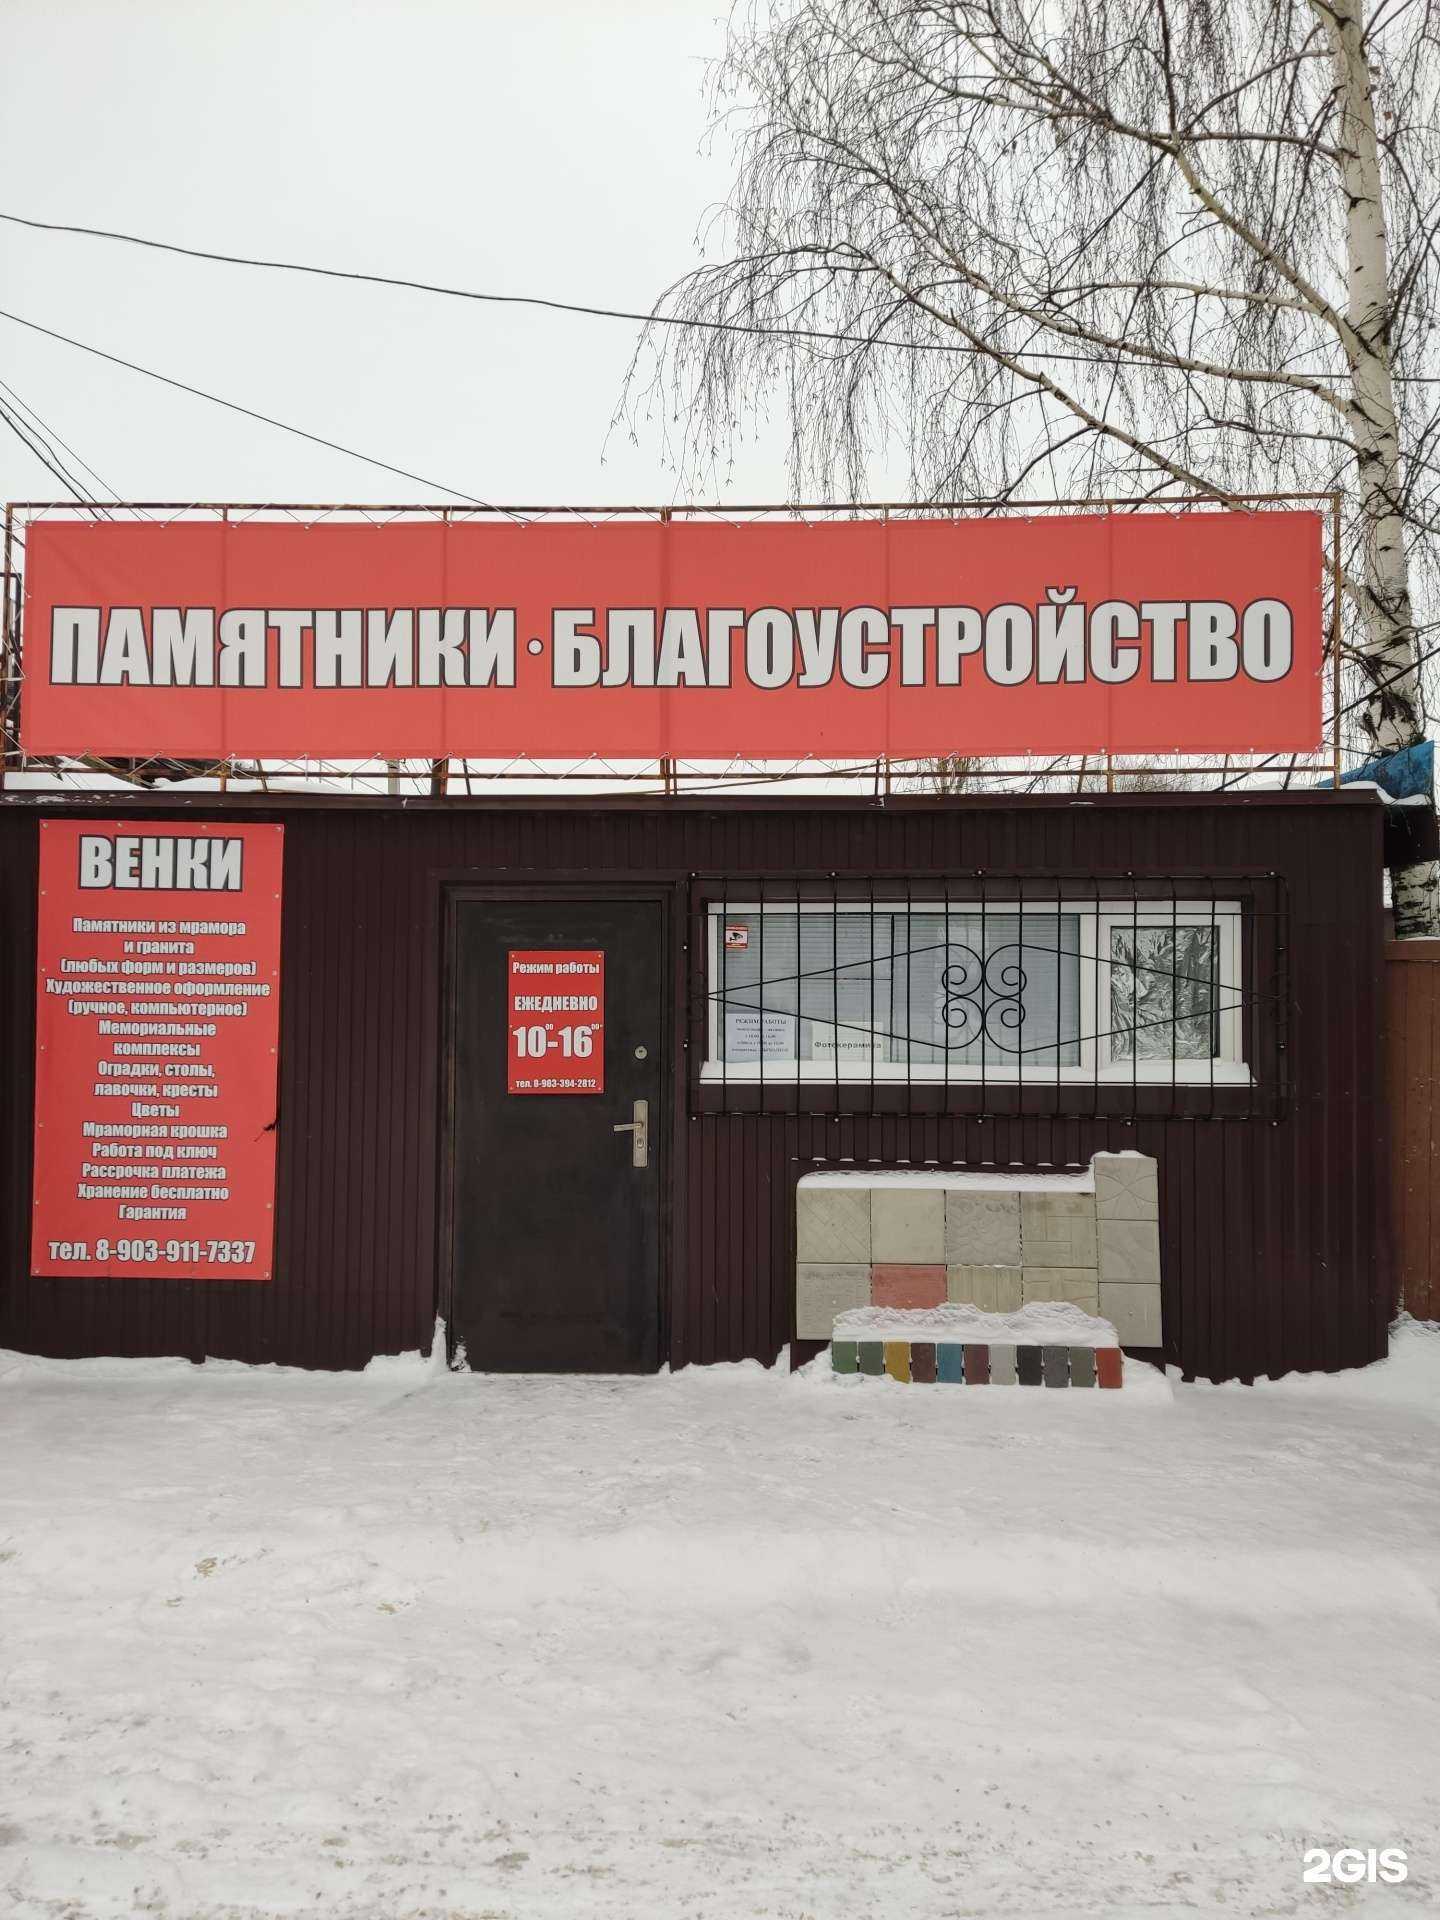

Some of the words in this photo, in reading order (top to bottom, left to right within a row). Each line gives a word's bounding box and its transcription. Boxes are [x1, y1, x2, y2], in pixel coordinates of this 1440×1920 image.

[50, 606, 517, 689] ПАМЯТНИКИ
[551, 586, 1294, 690] БЛАГОУСТРОЙСТВО
[79, 835, 243, 891] ВЕНКИ
[72, 917, 156, 934] Памятники
[158, 921, 176, 933] из
[179, 921, 246, 936] мрамора
[123, 941, 134, 953] и
[136, 941, 195, 955] гранита
[61, 959, 119, 974] (любых
[121, 961, 164, 975] форм
[166, 962, 177, 974] и
[178, 961, 257, 976] размеров)
[512, 962, 553, 974] Режим
[555, 962, 600, 975] работы
[46, 979, 171, 994] Художественное
[174, 982, 271, 996] оформление
[68, 999, 128, 1015] (ручное,
[131, 1002, 247, 1016] компьютерное)
[514, 995, 598, 1012] ЕЖЕДНЕВНО
[98, 1019, 216, 1037] Мемориальные
[113, 1042, 200, 1056] комплексы
[97, 1061, 162, 1077] Оградки,
[165, 1064, 215, 1078] столы,
[94, 1083, 160, 1097] лавочки,
[162, 1085, 218, 1098] кресты
[515, 1080, 532, 1088] тел.
[131, 1102, 180, 1118] Цветы
[82, 1122, 168, 1138] Мраморная
[170, 1125, 228, 1138] крошка
[92, 1142, 143, 1158] Работа
[145, 1145, 174, 1160] под
[176, 1145, 217, 1159] ключ
[82, 1163, 159, 1179] Рассрочка
[161, 1166, 227, 1180] платежа
[77, 1183, 148, 1199] Хранение
[151, 1185, 229, 1200] бесплатно
[119, 1204, 187, 1220] Гарантия
[48, 1240, 91, 1261] тел.
[95, 1239, 256, 1263] 8-903-911-7337
